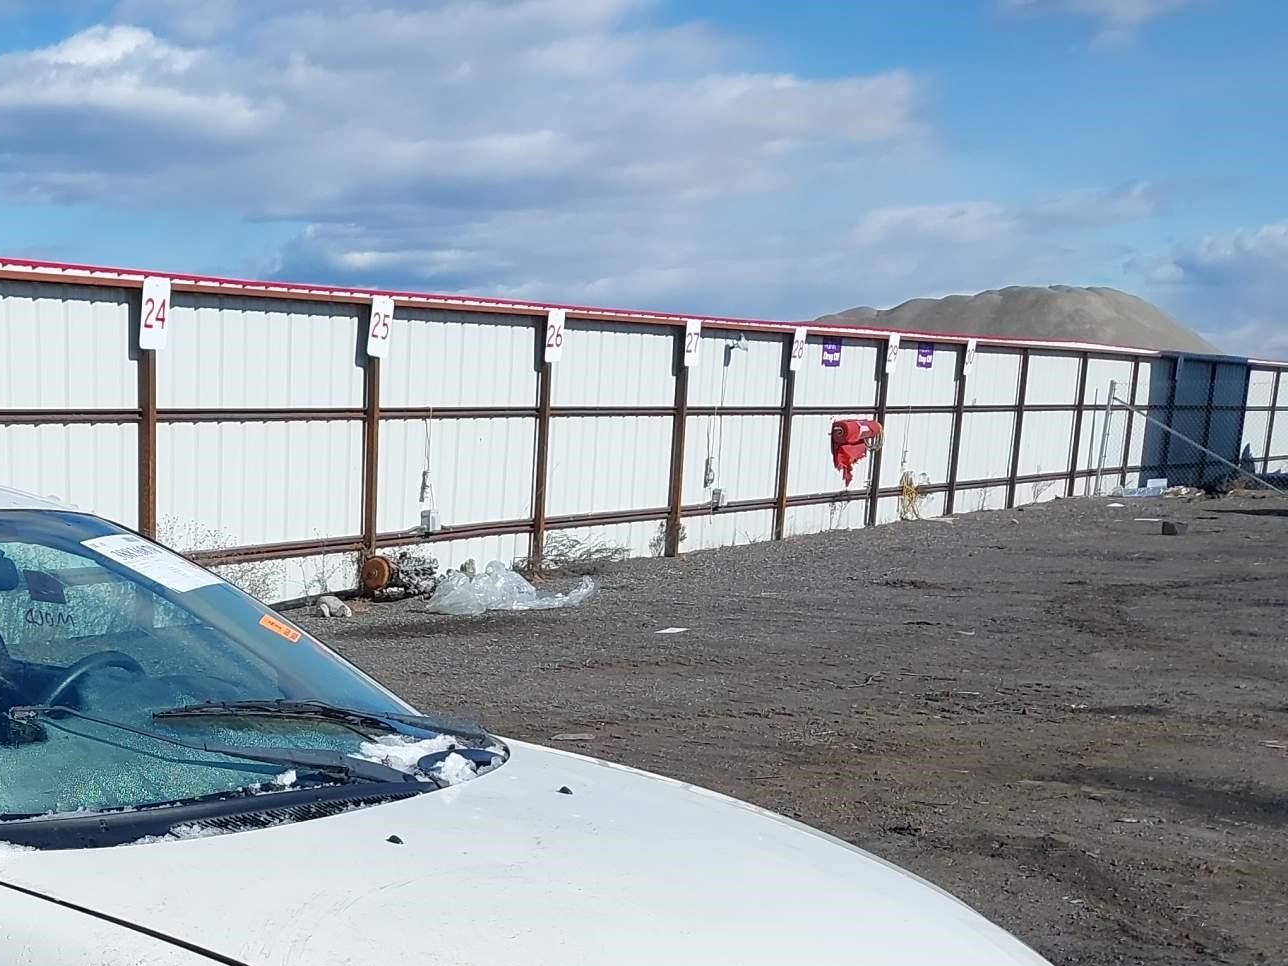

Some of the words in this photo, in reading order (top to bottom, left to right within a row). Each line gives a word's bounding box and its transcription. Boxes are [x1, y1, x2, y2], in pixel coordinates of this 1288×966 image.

[144, 297, 166, 330] 24
[371, 311, 391, 341] 25
[546, 324, 563, 348] 26
[685, 332, 700, 354] 27
[791, 339, 804, 360] 28
[887, 344, 899, 363] 29
